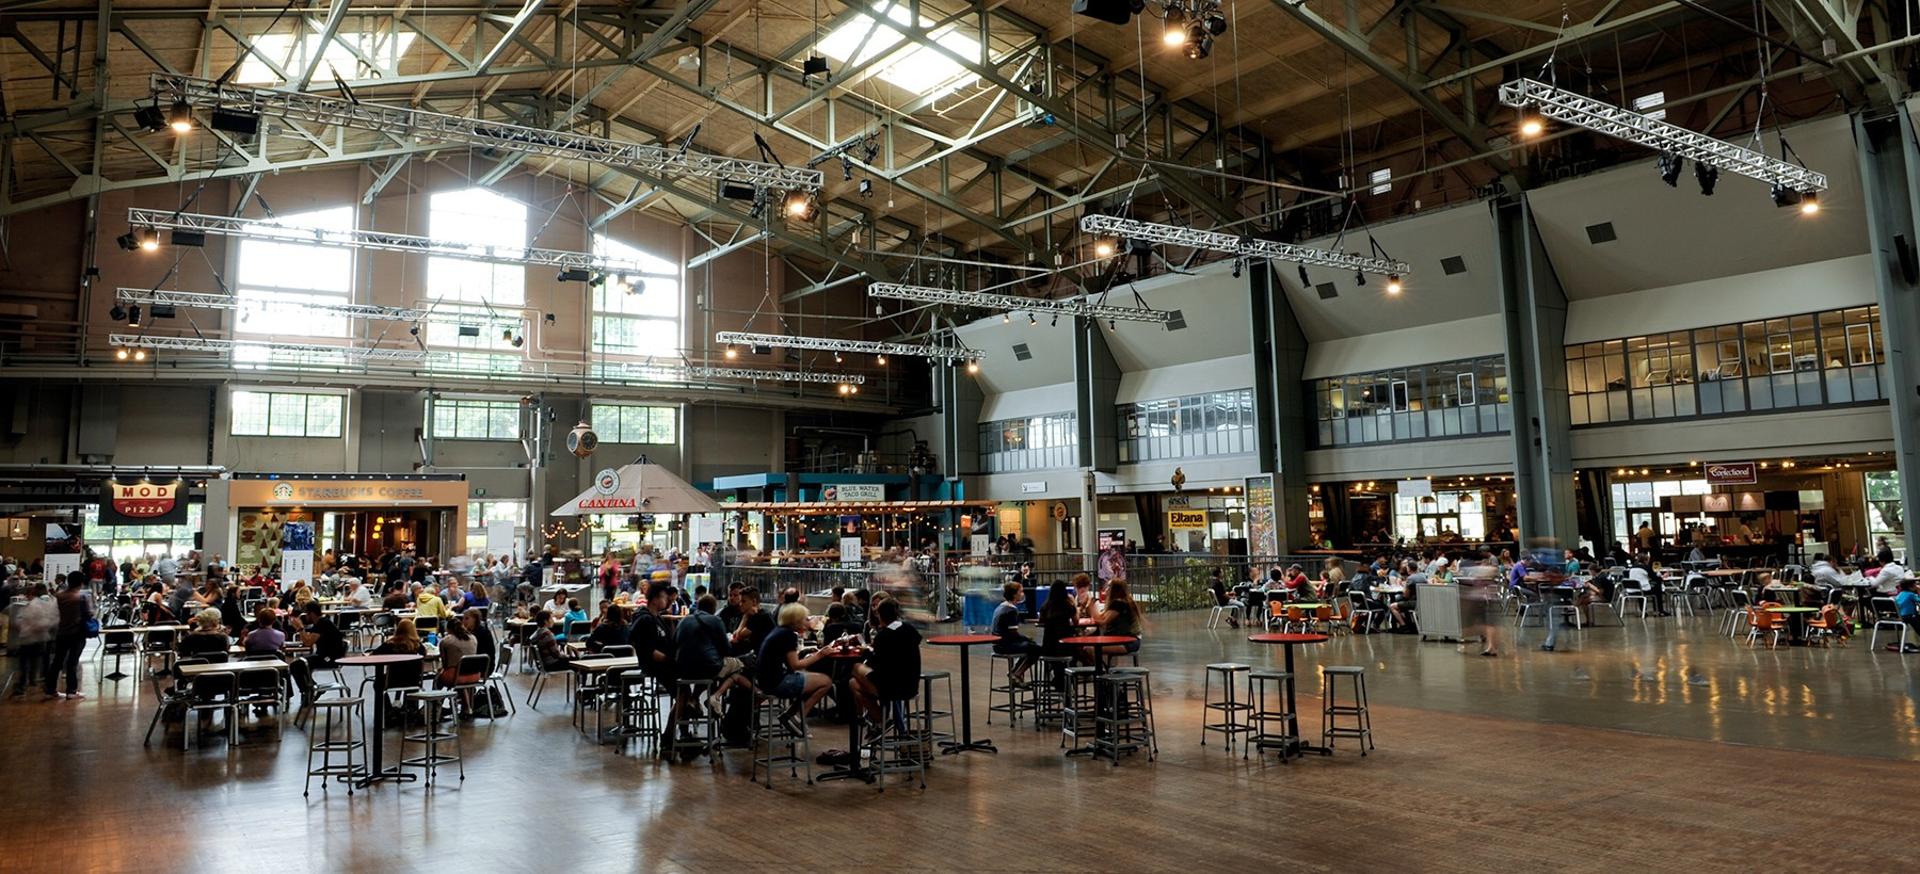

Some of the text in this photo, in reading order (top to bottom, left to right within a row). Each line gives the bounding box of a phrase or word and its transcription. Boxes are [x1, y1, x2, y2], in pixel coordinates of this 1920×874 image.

[1711, 467, 1749, 478] Confectional
[122, 487, 167, 497] MOD
[299, 486, 424, 498] STARBUCKS COFFEE
[578, 498, 636, 509] CANTINA
[1171, 512, 1203, 523] Eltana
